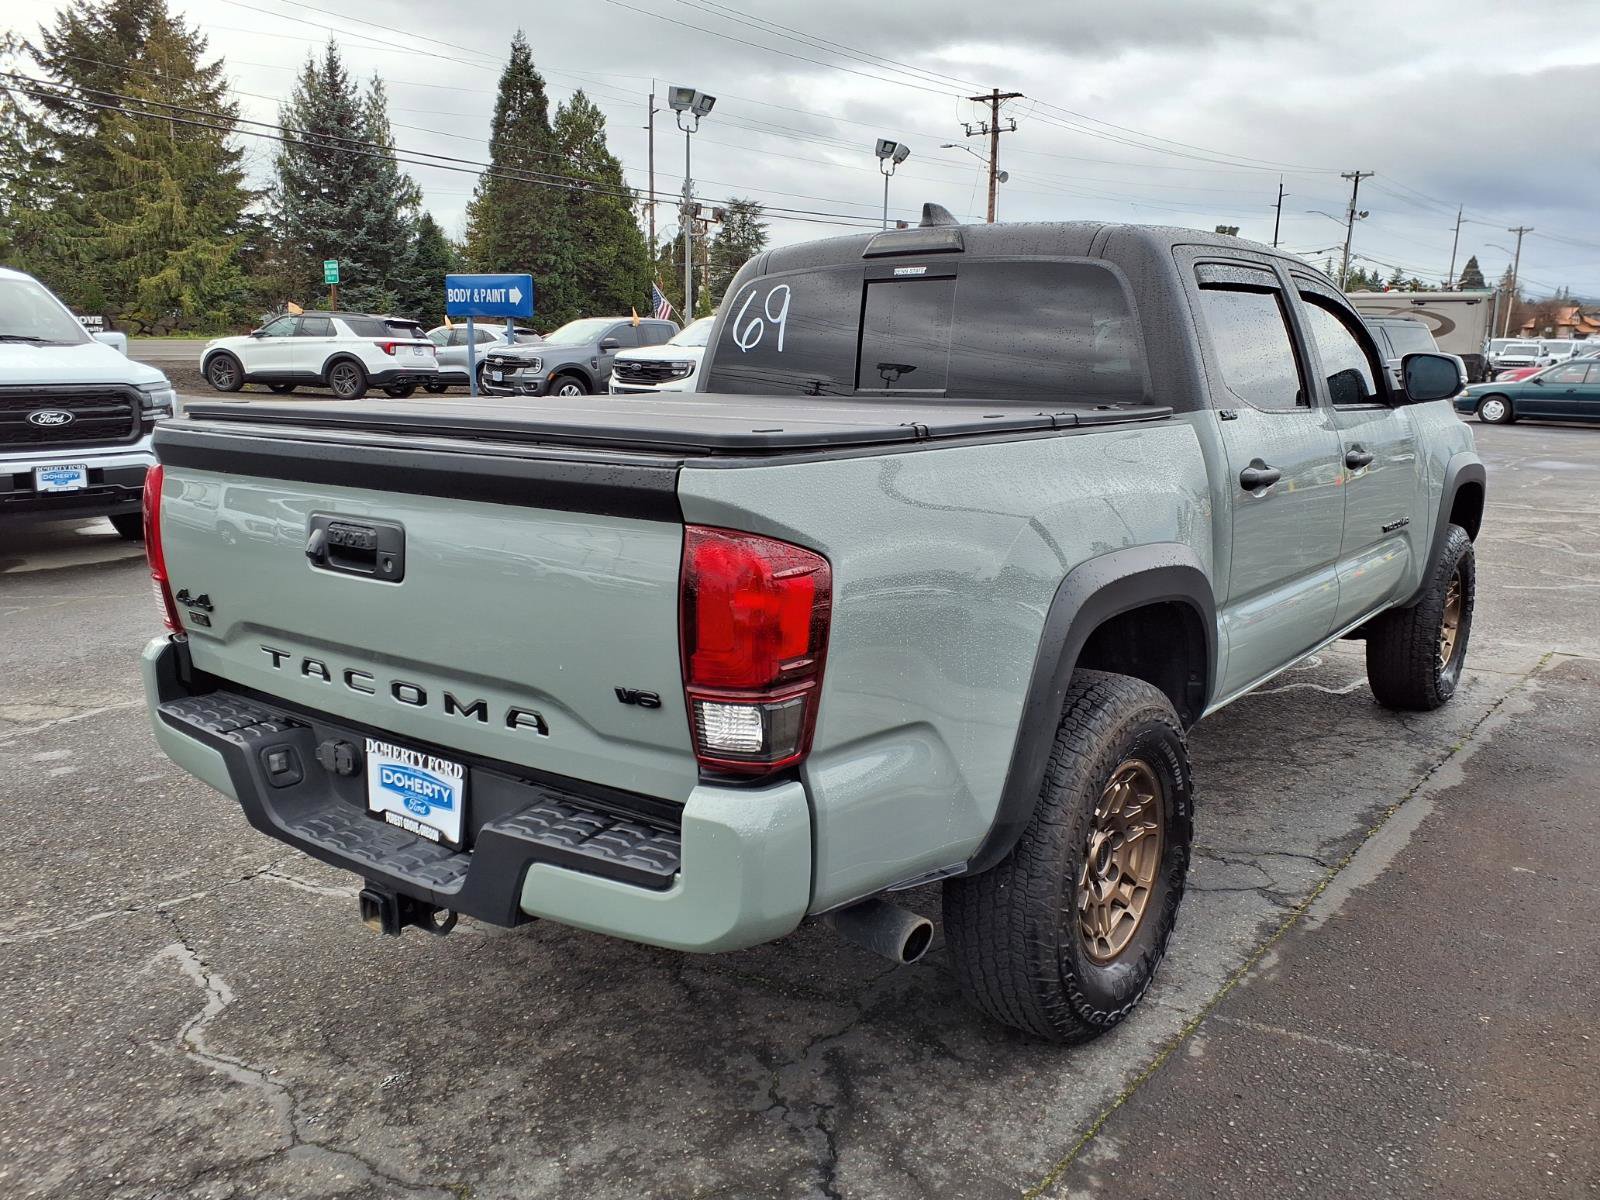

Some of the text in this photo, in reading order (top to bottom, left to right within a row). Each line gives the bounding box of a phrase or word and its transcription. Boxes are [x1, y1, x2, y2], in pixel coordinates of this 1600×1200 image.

[447, 288, 507, 303] BODY & PAINT
[78, 315, 103, 325] OVE
[732, 284, 791, 353] 69
[38, 412, 65, 424] Ford
[328, 529, 370, 548] TOYOTA
[260, 645, 550, 737] TACOMA
[614, 686, 662, 709] V6
[365, 738, 463, 779] DOHERTY FORD
[382, 769, 451, 803] DOHERTY
[408, 798, 428, 815] Ford
